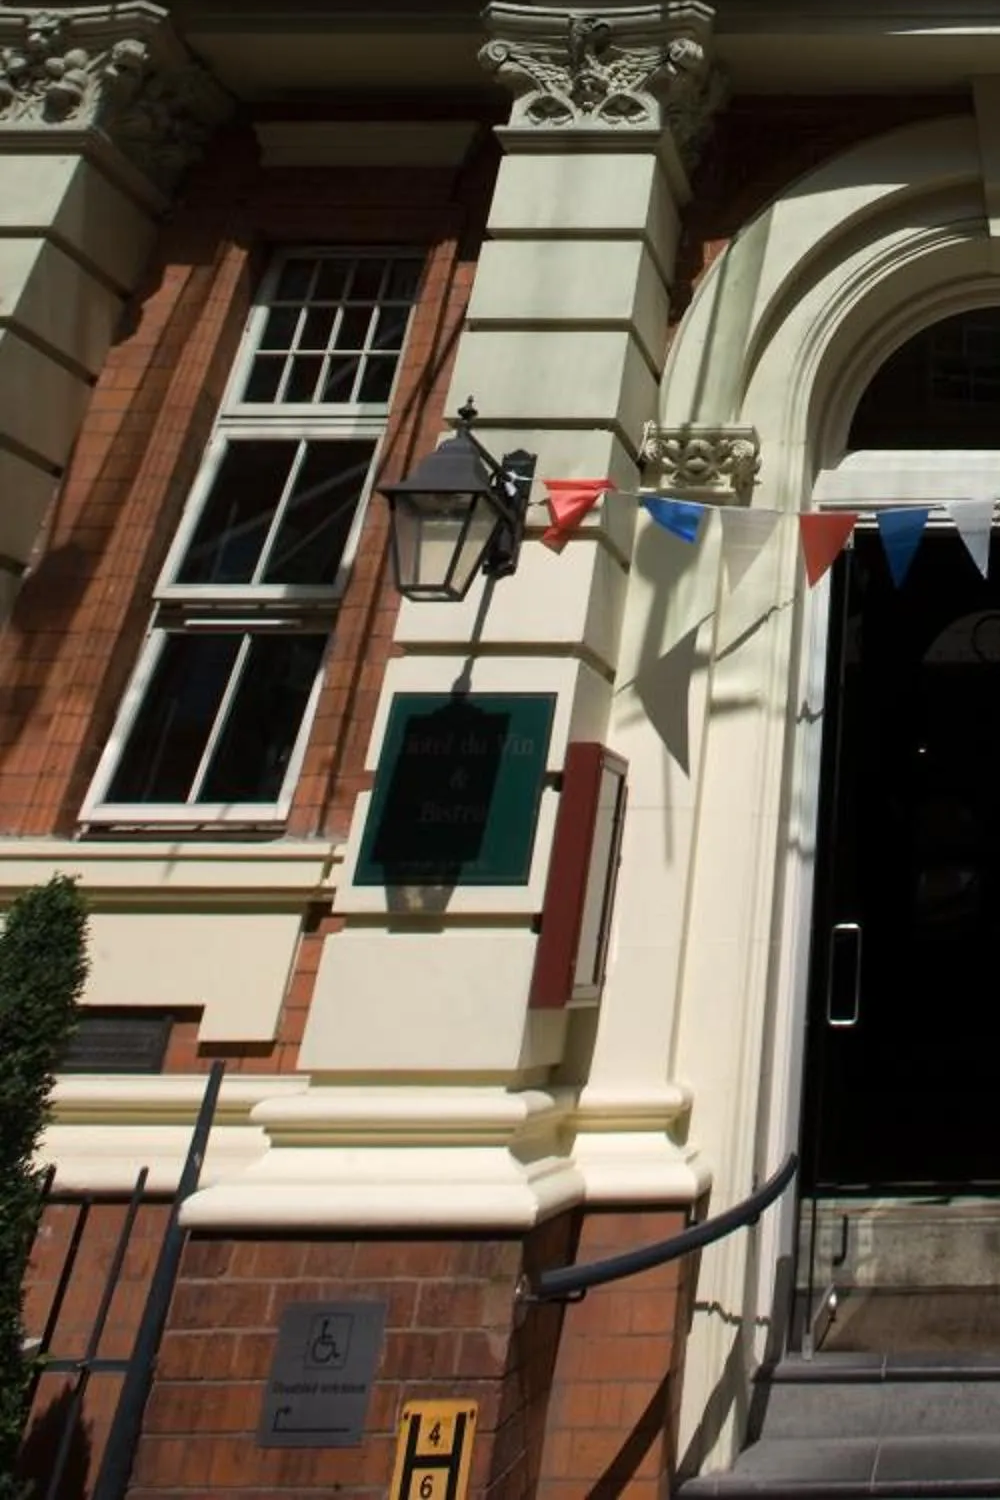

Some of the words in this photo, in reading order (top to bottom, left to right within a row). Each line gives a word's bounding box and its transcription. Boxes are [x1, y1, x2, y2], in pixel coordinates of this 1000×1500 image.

[460, 731, 488, 755] du
[498, 732, 534, 755] Vin
[428, 1421, 441, 1446] 4
[419, 1475, 433, 1499] 6
